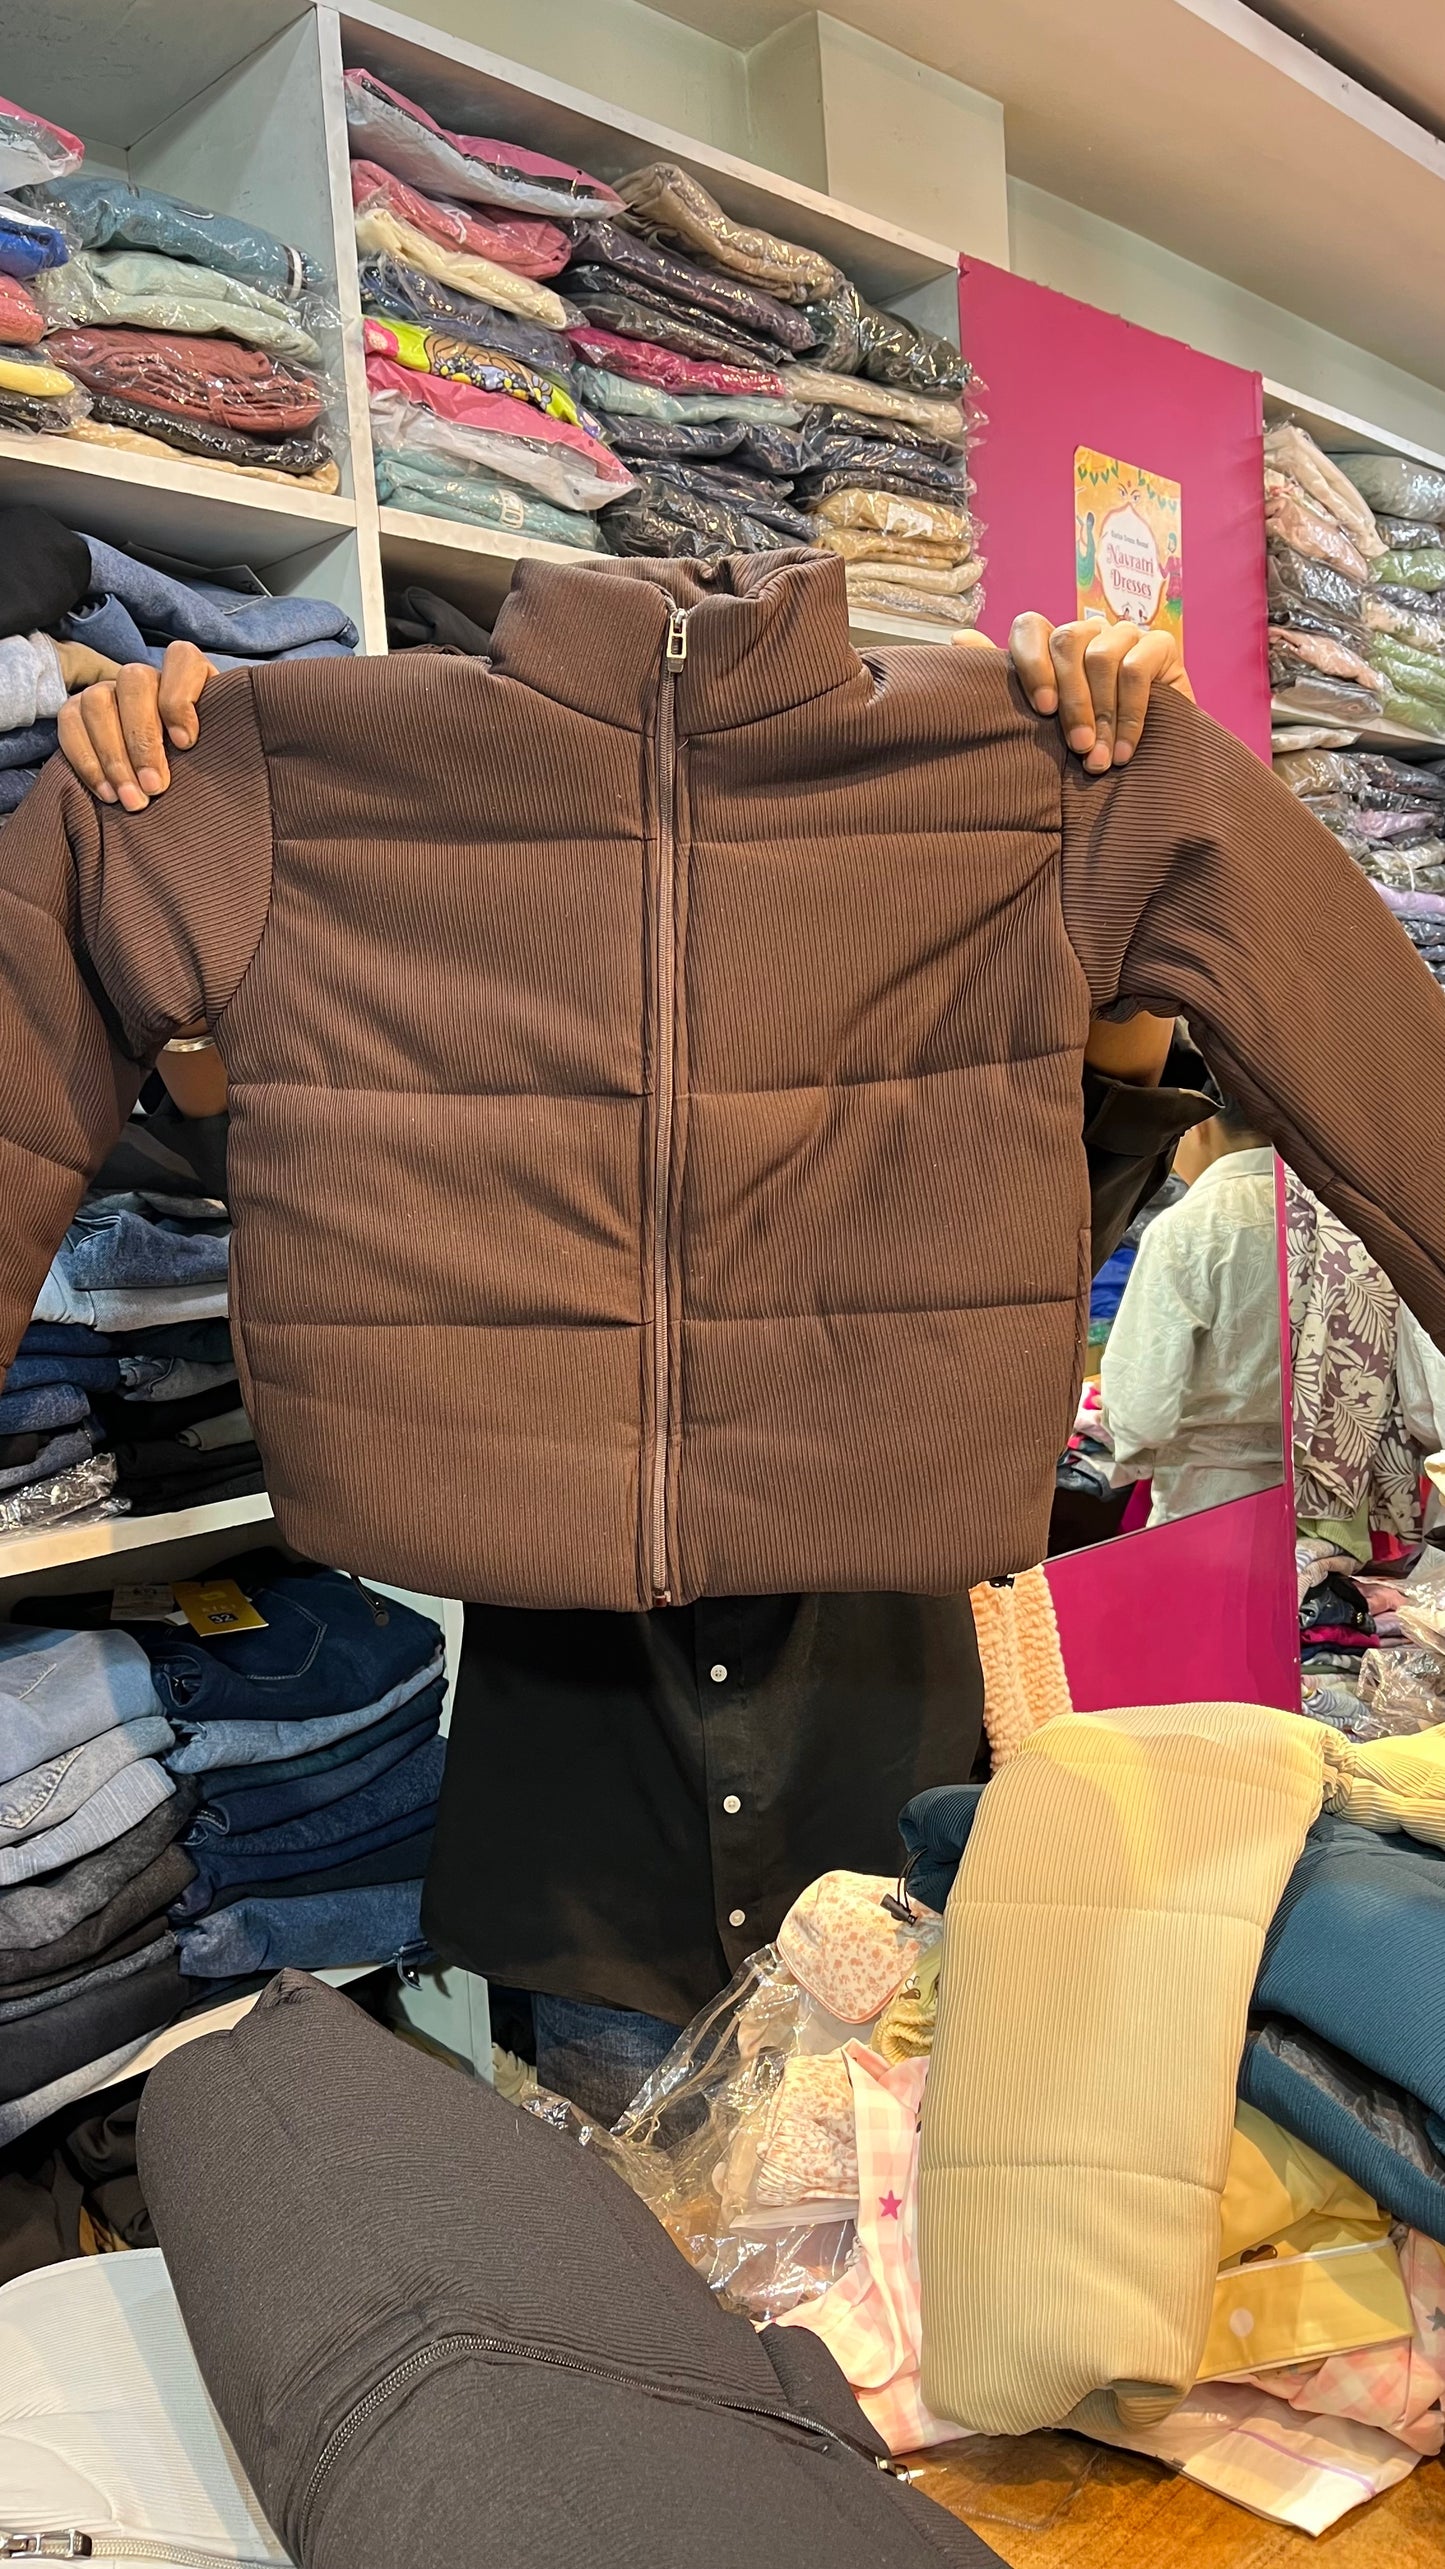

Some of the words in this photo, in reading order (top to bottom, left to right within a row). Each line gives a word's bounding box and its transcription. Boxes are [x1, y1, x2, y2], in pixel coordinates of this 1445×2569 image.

[1107, 543, 1154, 575] Navratri
[1111, 569, 1152, 597] Dresses
[210, 1613, 234, 1623] 32
